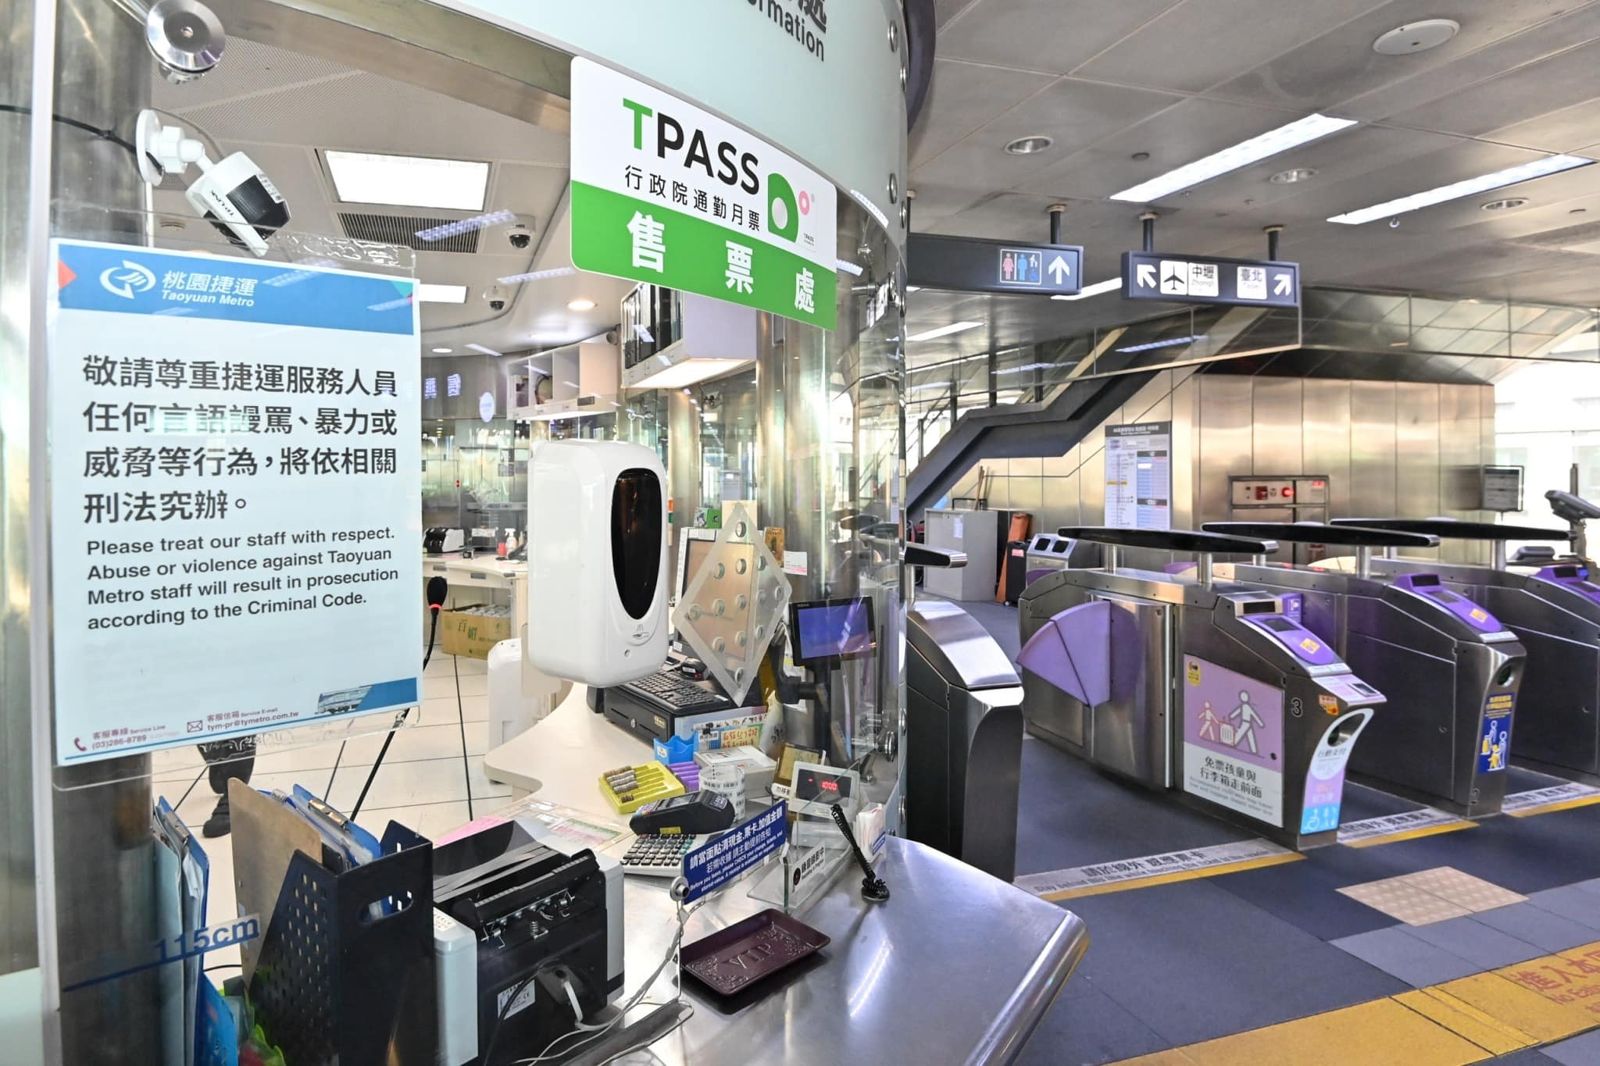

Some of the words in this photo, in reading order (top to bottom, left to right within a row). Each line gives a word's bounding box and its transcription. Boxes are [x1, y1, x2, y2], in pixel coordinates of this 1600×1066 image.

[623, 97, 760, 196] TPASS
[624, 163, 760, 233] 行政院通勤月票
[162, 270, 258, 296] 桃園捷運
[162, 289, 216, 304] Taoyuan
[219, 294, 255, 307] Metro
[83, 355, 398, 398] 敬請尊重捷運服務人員
[83, 401, 398, 436] 任何言語謾罵、暴力或
[84, 489, 247, 524] 刑法究辦。
[87, 540, 154, 555] Please
[160, 536, 204, 551] treat
[210, 537, 241, 549] our
[246, 531, 286, 547] staff
[291, 530, 326, 544] with
[332, 526, 395, 543] respect.
[87, 565, 150, 580] Abuse
[157, 564, 176, 575] or
[182, 558, 257, 574] violence
[263, 552, 323, 571] against
[328, 549, 392, 565] Taoyuan
[88, 590, 144, 605] Metro
[150, 583, 192, 601] staff
[198, 580, 227, 596] will
[233, 577, 282, 593] result
[287, 575, 301, 589] in
[307, 569, 398, 590] prosecution
[88, 609, 185, 630] according
[191, 607, 209, 620] to
[214, 604, 242, 618] the
[248, 595, 317, 615] Criminal
[322, 592, 367, 608] Code.
[1291, 697, 1303, 718] 3
[154, 918, 260, 959] 115cm
